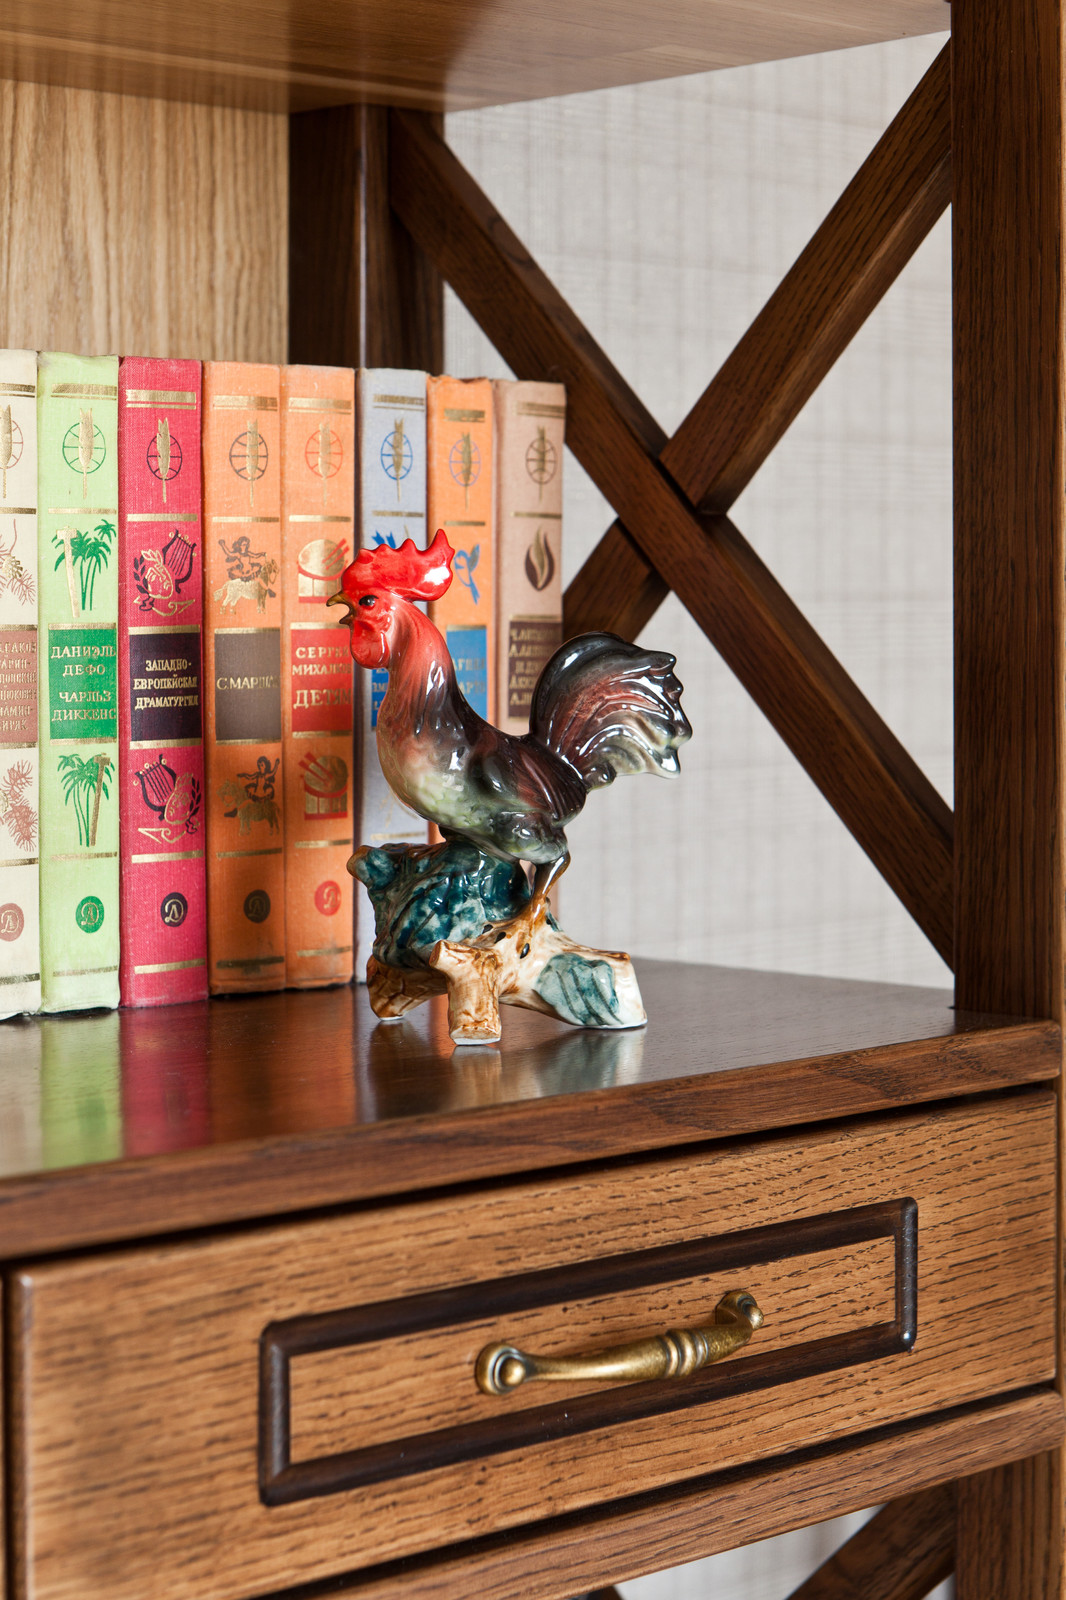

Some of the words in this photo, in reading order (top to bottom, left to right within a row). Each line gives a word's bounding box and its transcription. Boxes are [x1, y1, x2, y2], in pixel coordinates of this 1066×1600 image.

[50, 645, 116, 659] ДАНИЭЛЬ
[62, 664, 106, 677] ДЕФО
[133, 674, 198, 690] ЕВРОПЕЙСКАЯ
[59, 690, 112, 703] ЧАРЛЬЗ
[134, 695, 199, 711] ДРАМАТУРГИЯ
[293, 688, 352, 710] ДЕТЯМ
[51, 708, 116, 722] ДИККЕНС
